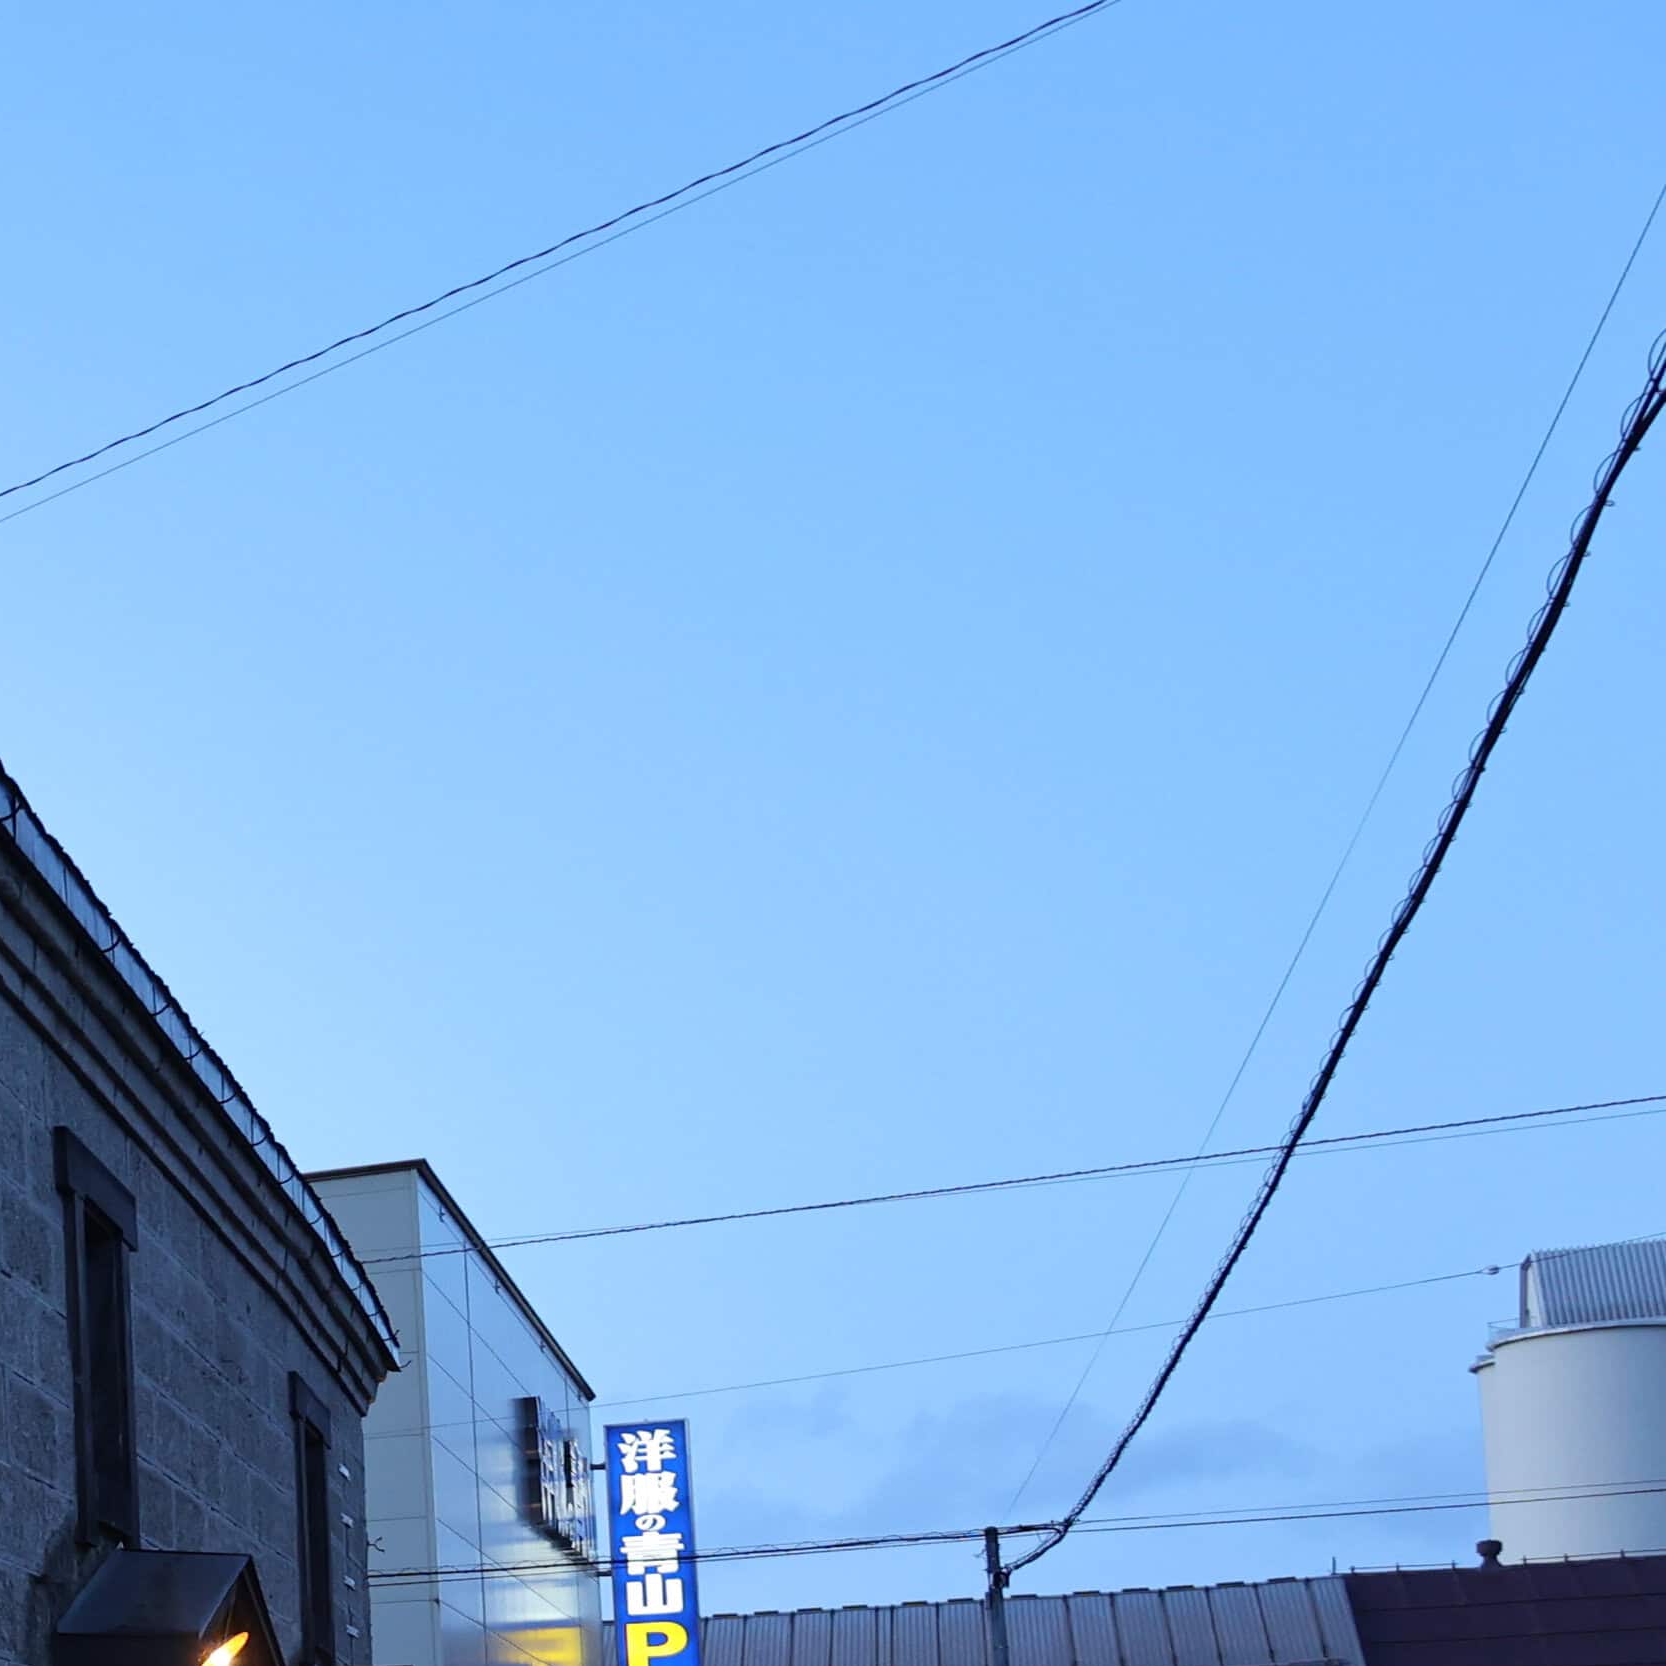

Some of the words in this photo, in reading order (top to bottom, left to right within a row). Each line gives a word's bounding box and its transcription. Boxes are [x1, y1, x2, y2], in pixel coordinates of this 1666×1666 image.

[617, 1428, 685, 1617] 洋服の青山
